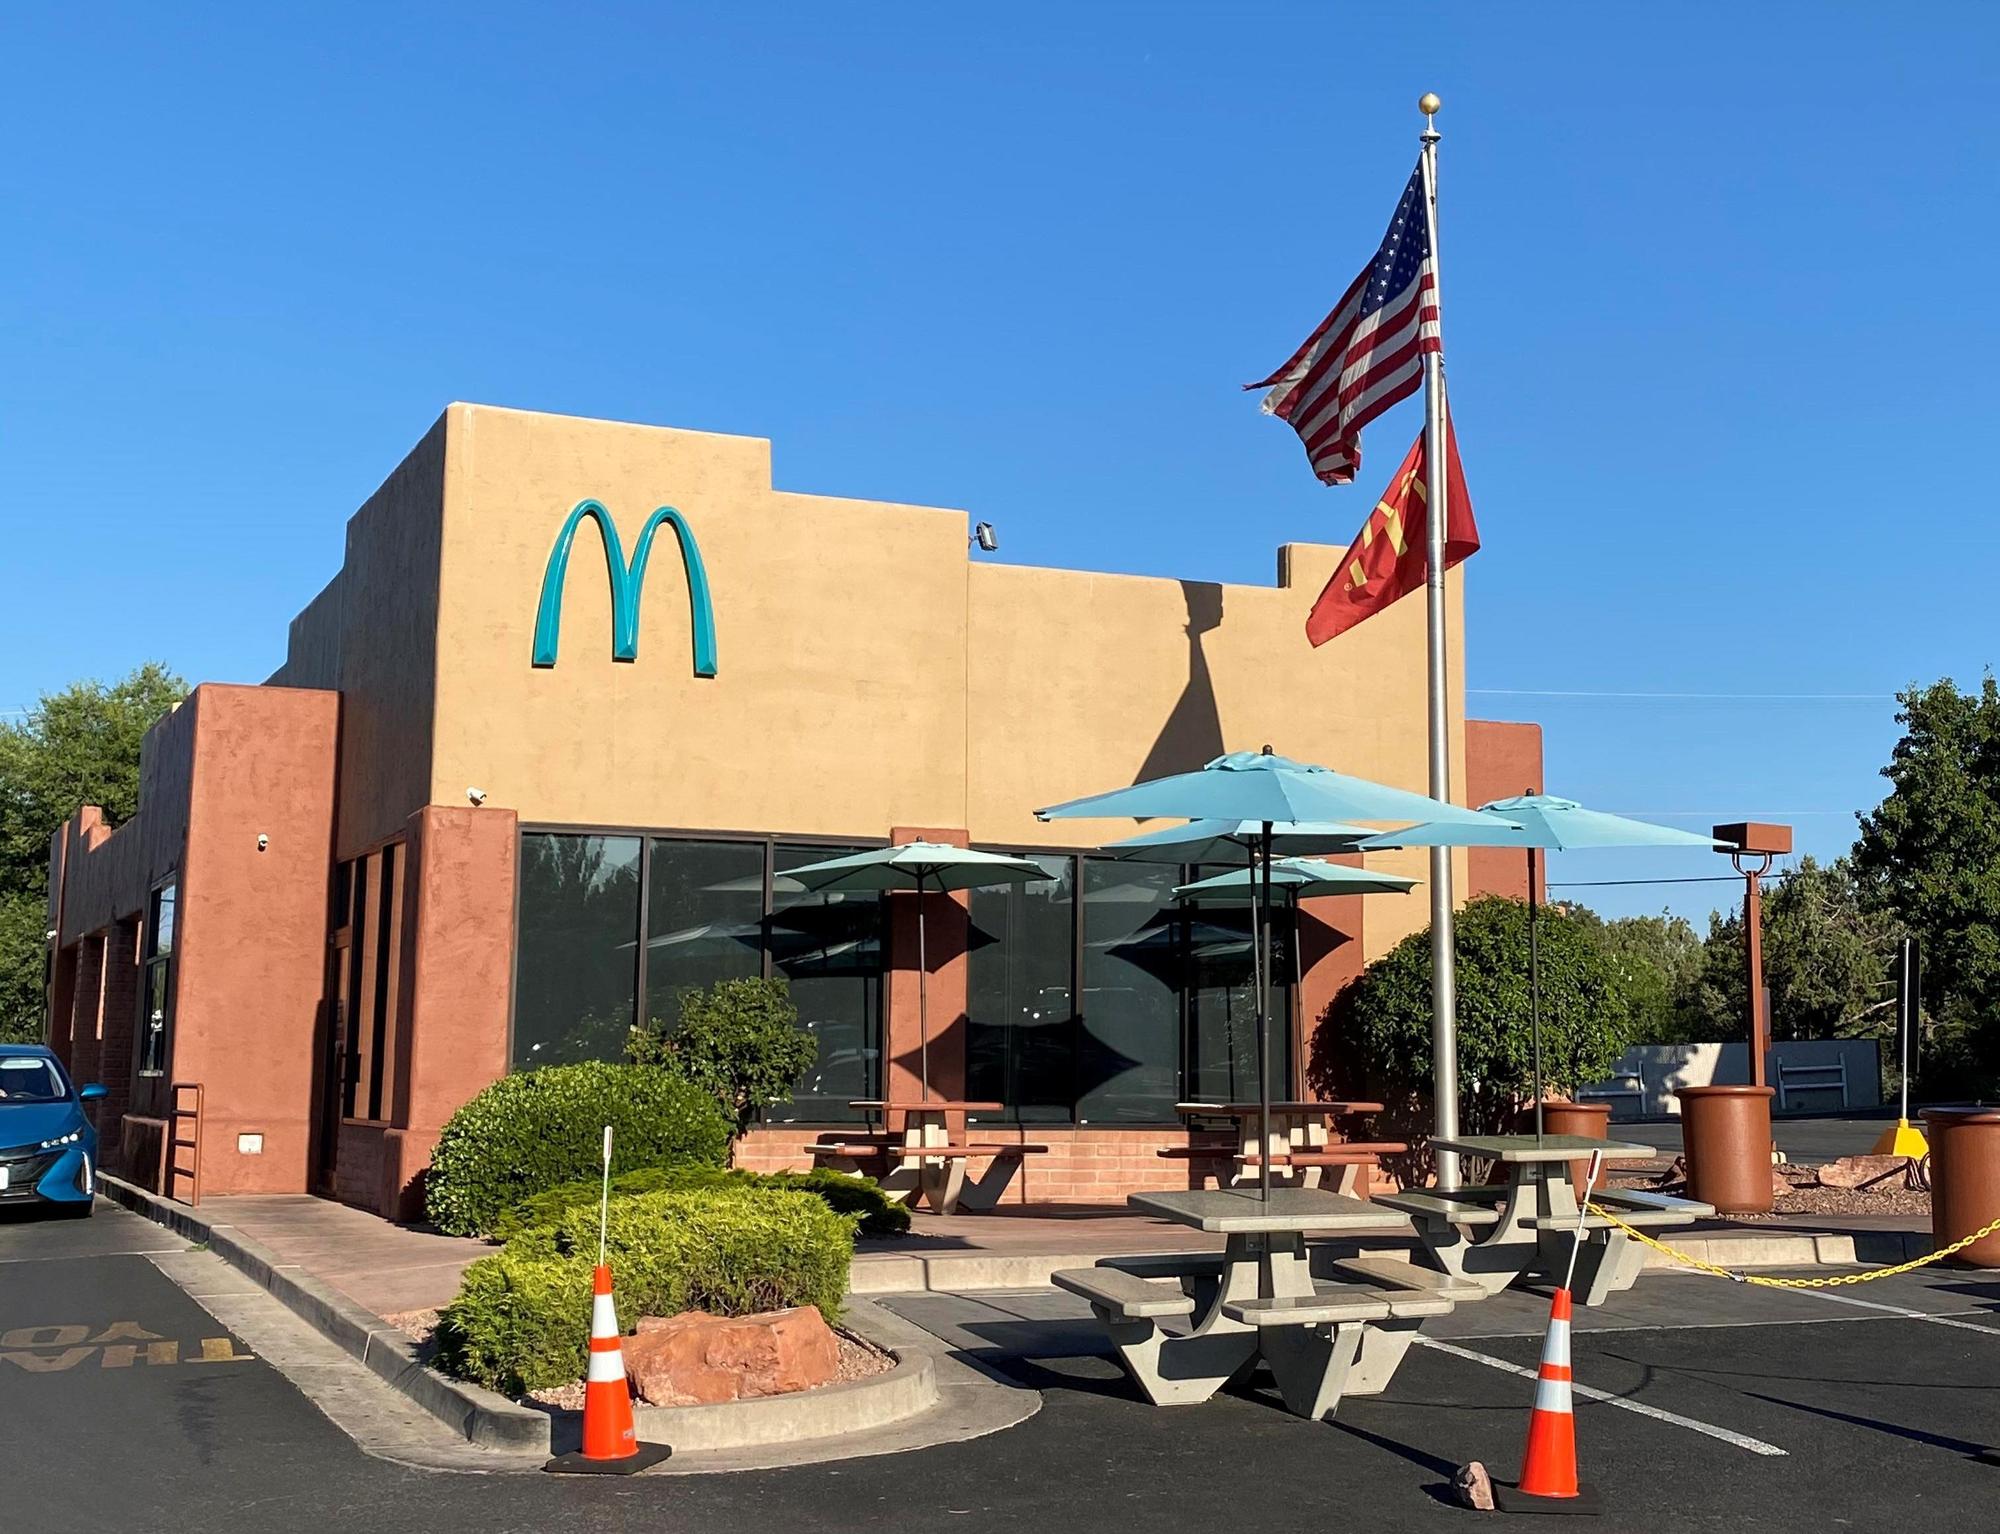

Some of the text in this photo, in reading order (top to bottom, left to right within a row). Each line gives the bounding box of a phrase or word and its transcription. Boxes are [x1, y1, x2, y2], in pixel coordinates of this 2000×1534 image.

[531, 498, 717, 679] M
[0, 1321, 164, 1347] YO
[0, 1337, 256, 1372] THA
